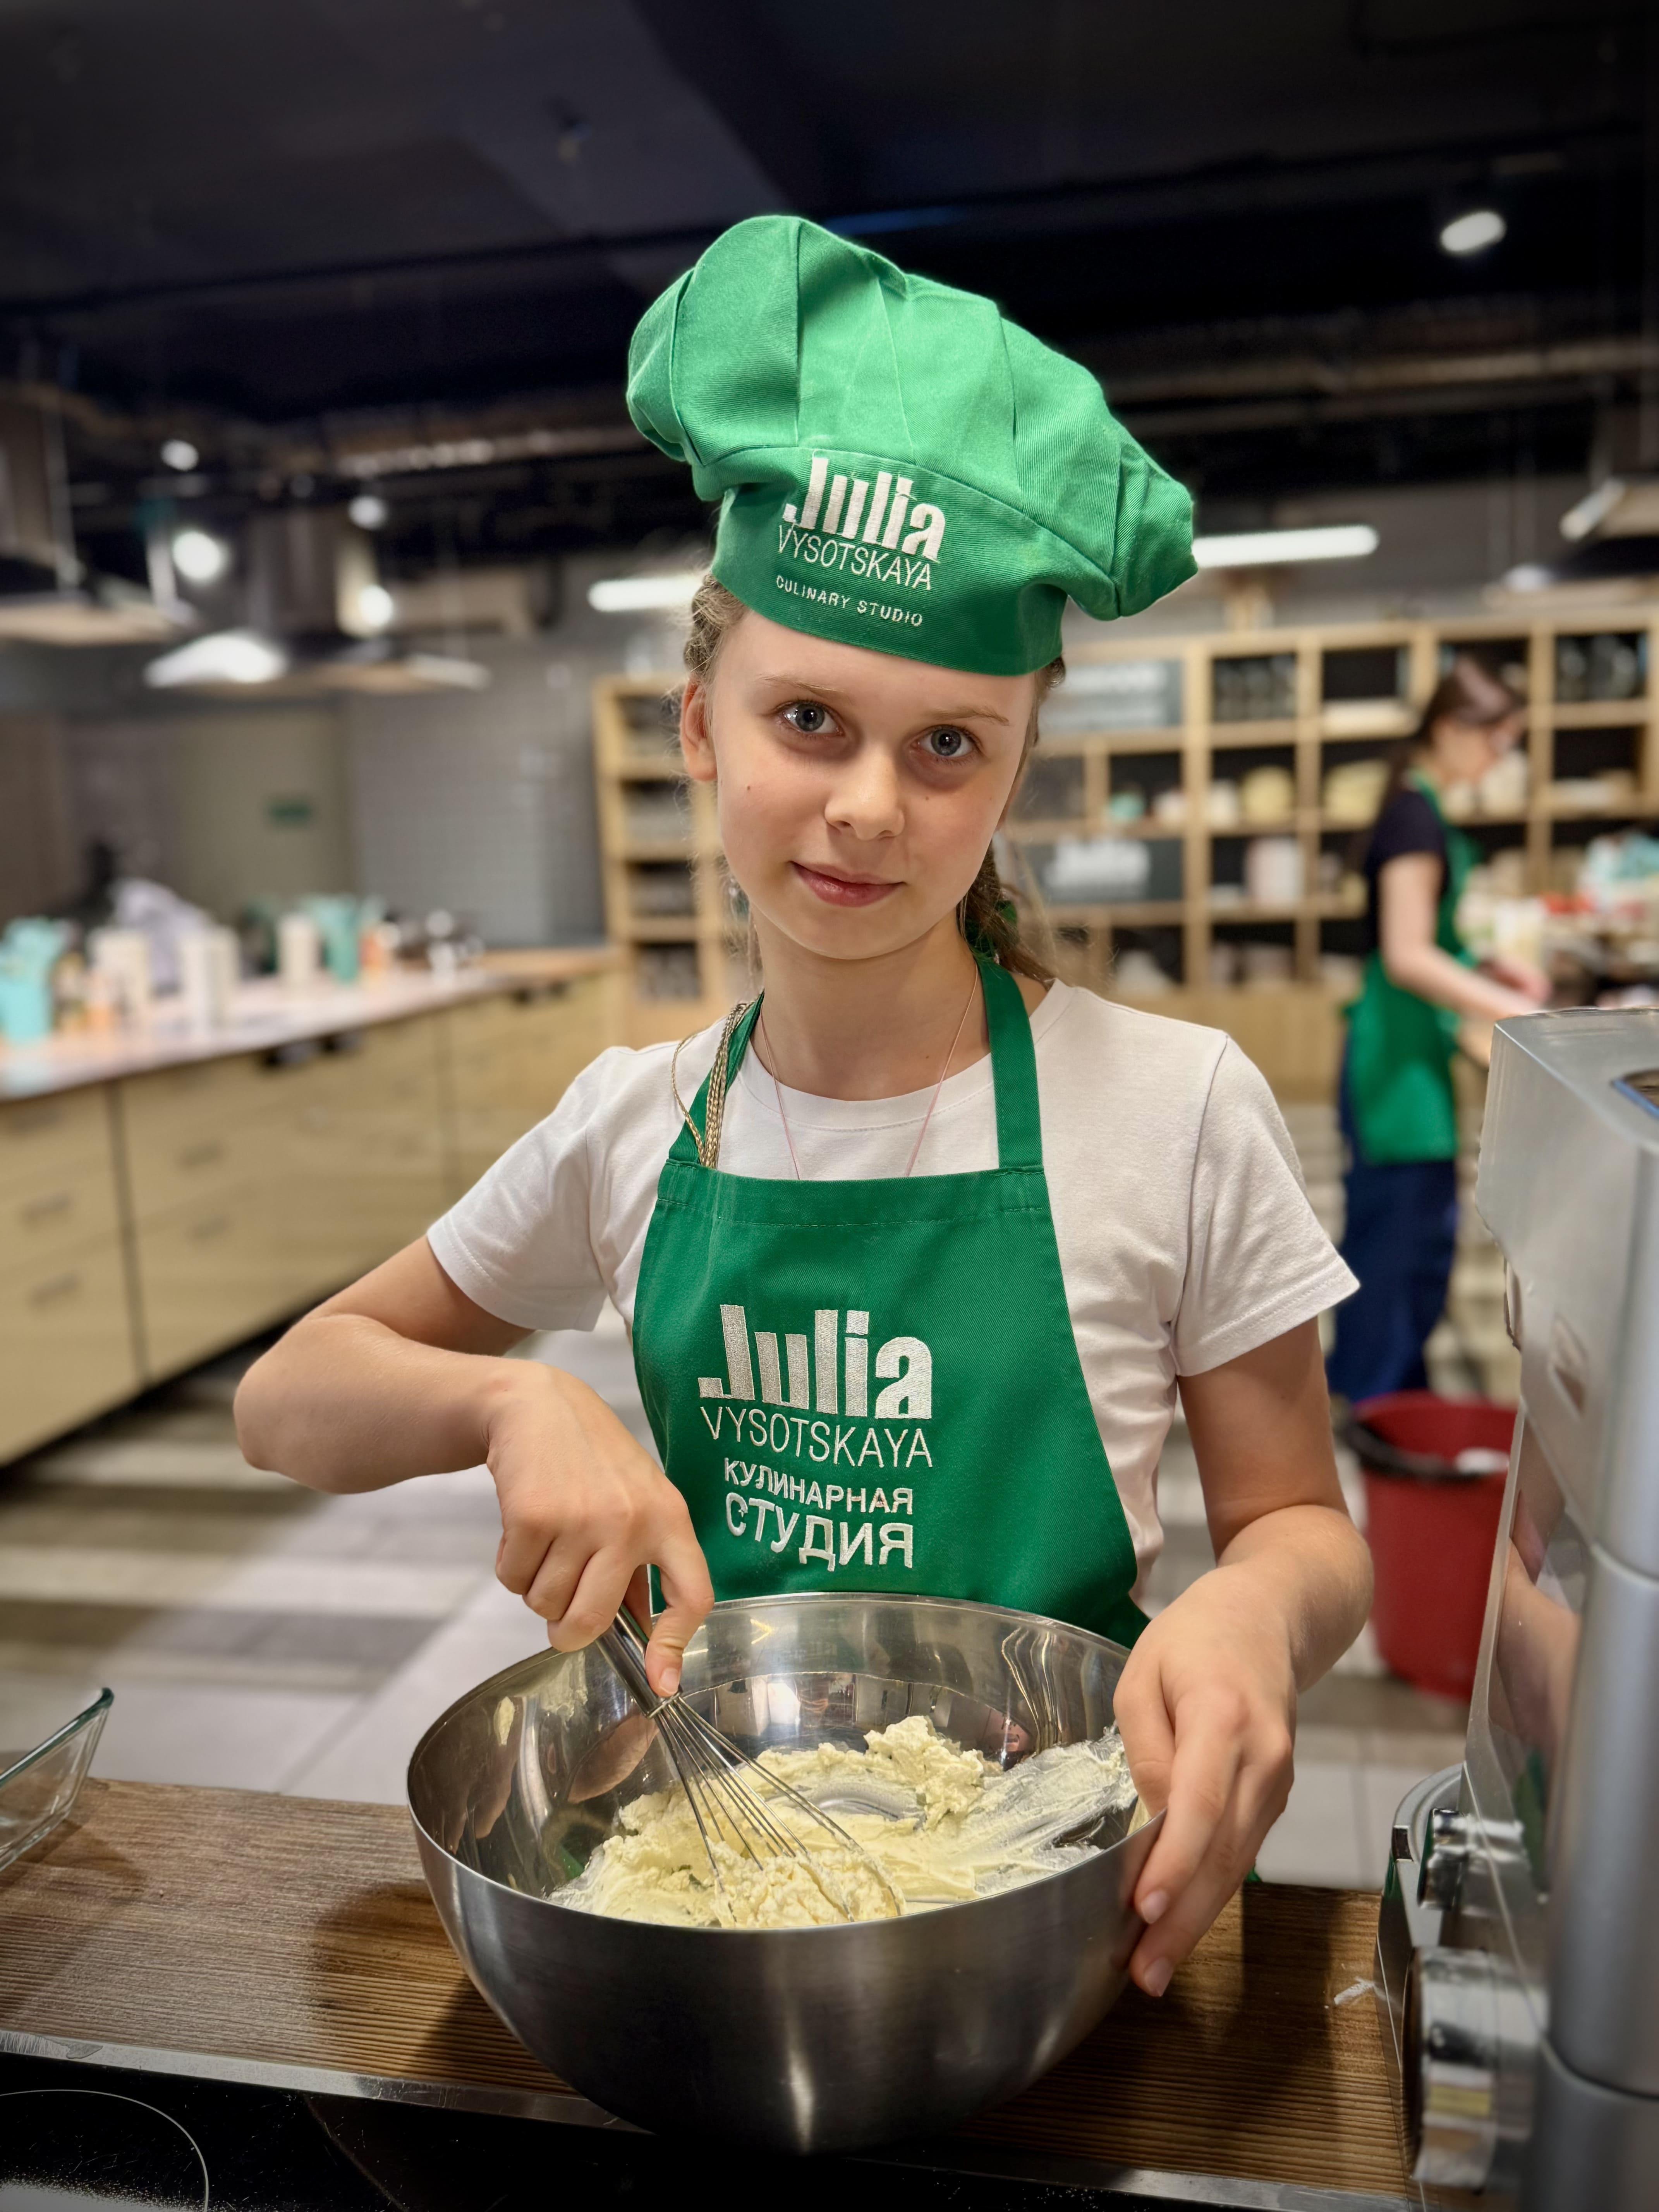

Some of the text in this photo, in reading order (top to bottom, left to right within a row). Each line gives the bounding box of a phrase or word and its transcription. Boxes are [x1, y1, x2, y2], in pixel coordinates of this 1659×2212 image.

[782, 457, 945, 561] Julia
[778, 525, 931, 590] VYSOTSKAYA
[776, 575, 922, 627] CULINARY STUDIO
[698, 1304, 932, 1419] Julia
[700, 1406, 933, 1468] VYSOTSKAYA
[724, 1457, 913, 1515] КУЛИНАРНАЯ
[726, 1492, 913, 1572] СТУДИЯ
